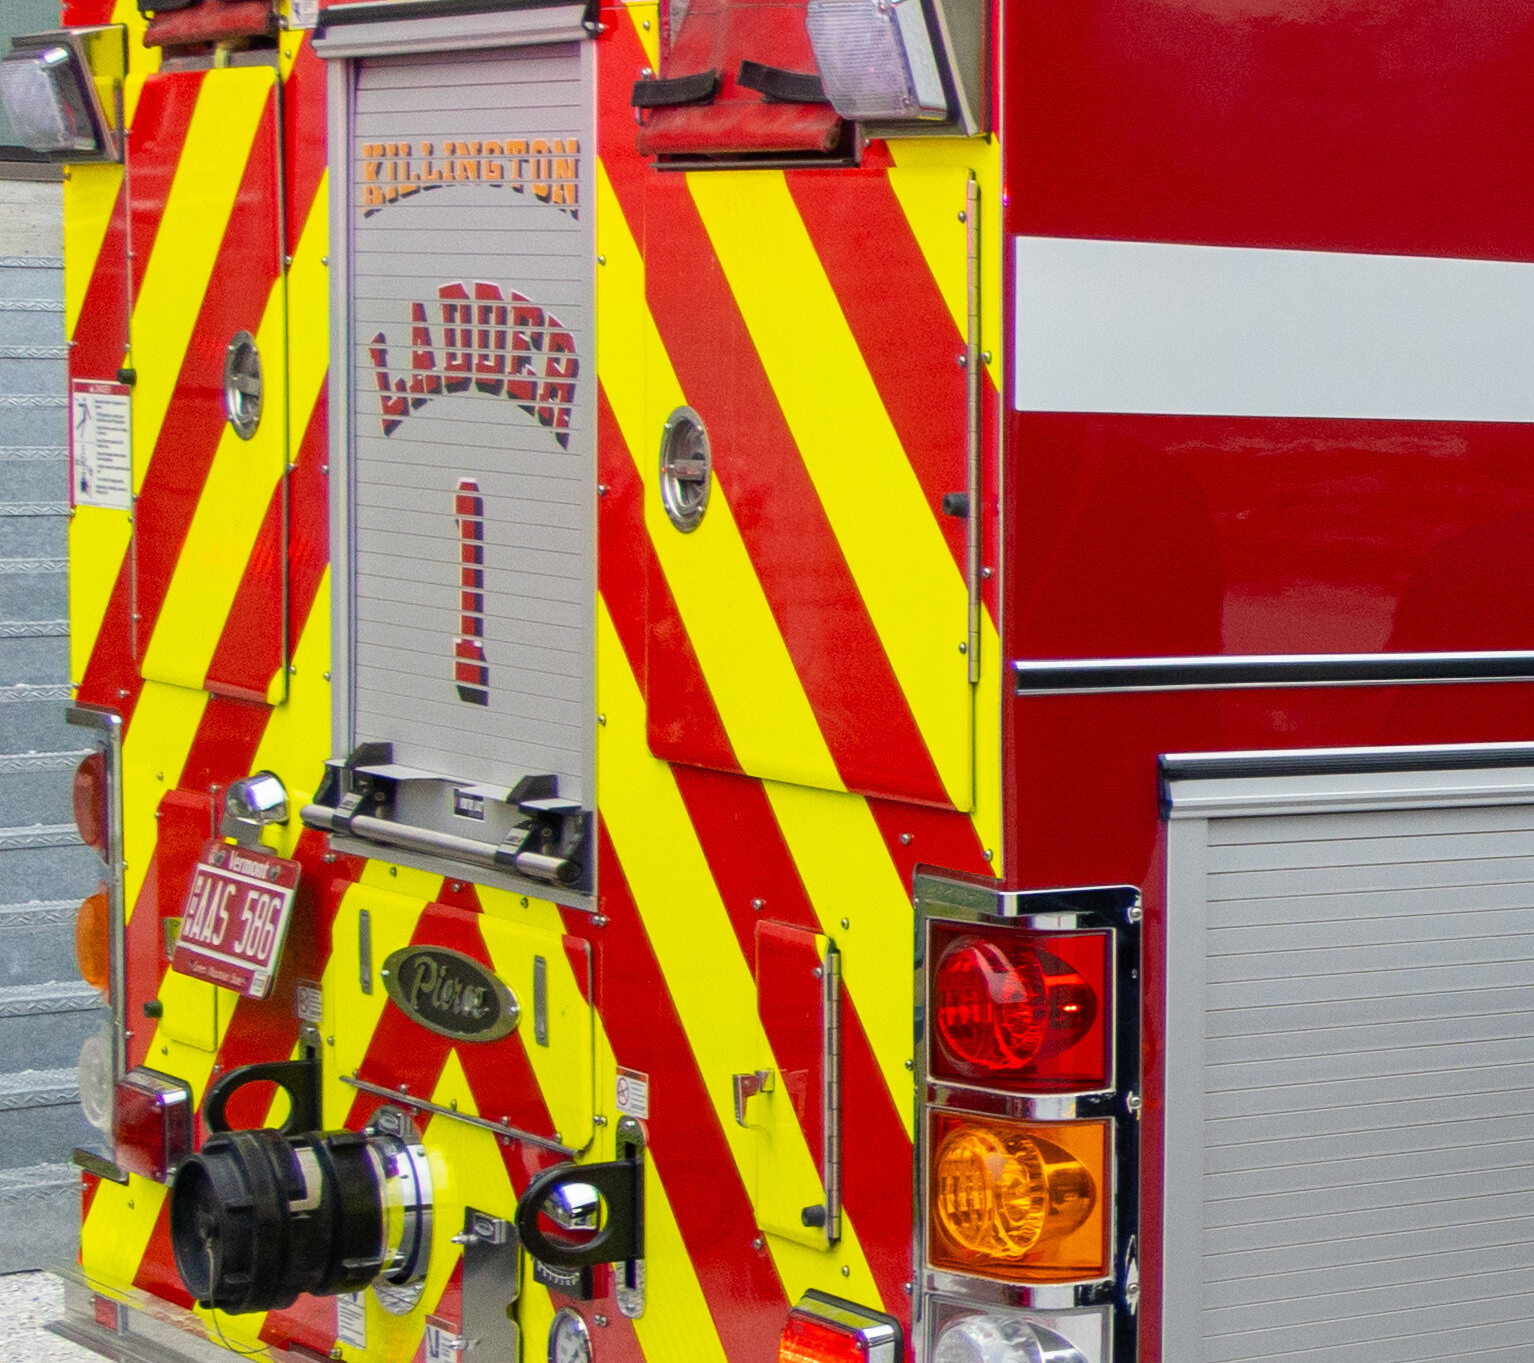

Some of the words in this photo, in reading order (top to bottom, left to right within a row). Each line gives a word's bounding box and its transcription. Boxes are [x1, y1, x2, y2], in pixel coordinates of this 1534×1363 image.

[362, 139, 579, 219] KILLINGTON
[368, 281, 579, 451] LADDER
[453, 477, 489, 706] 1
[228, 850, 271, 880] Vermont
[190, 877, 237, 946] AAS
[234, 889, 281, 961] 586
[410, 955, 489, 1019] Pierce
